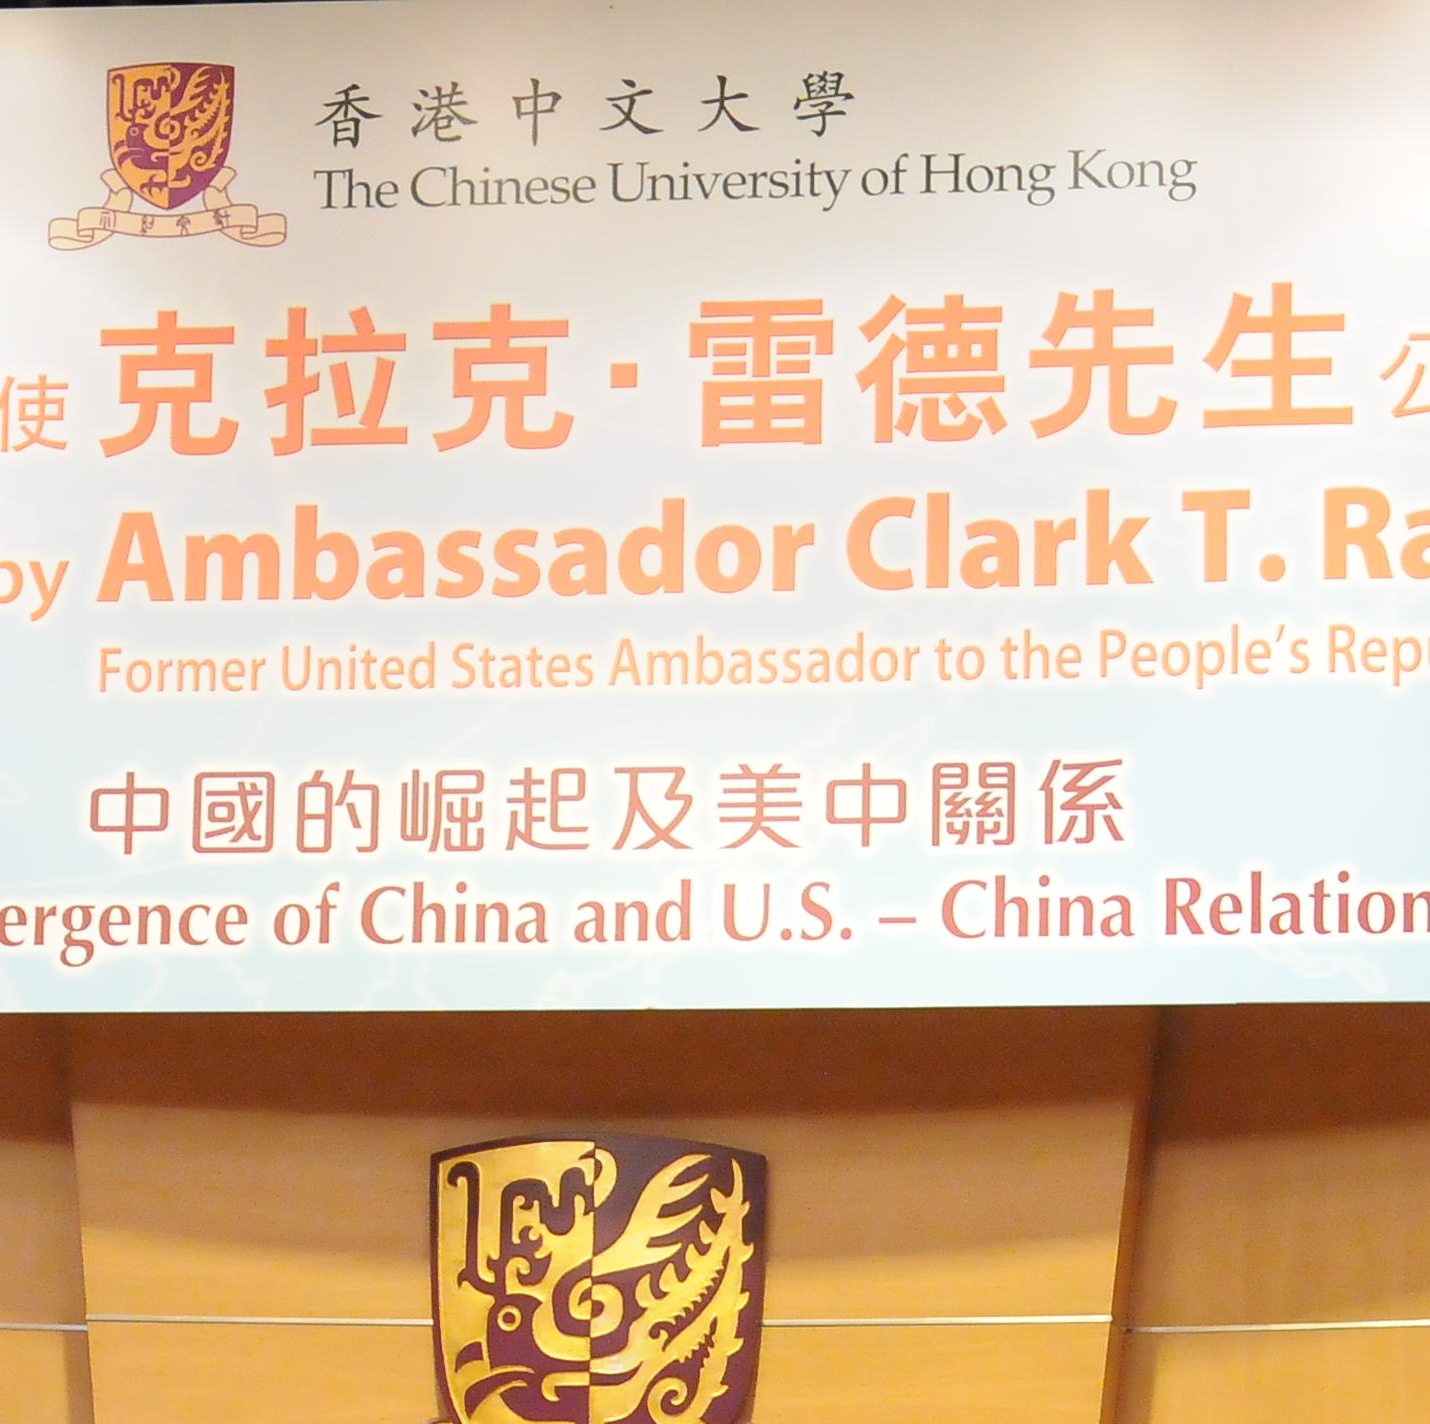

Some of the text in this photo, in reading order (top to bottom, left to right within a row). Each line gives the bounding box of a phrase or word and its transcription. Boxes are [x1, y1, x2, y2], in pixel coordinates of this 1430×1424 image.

[315, 70, 855, 148] 香港中文大學
[313, 148, 1198, 212] The Chinese University of Hong Kong
[96, 496, 815, 603] Ambassador
[846, 487, 1153, 591] Clark
[1182, 488, 1286, 583] T.
[99, 647, 267, 693] Former
[281, 640, 436, 692] United
[451, 641, 594, 689] States
[608, 631, 921, 686] Ambassador
[934, 638, 986, 681] to
[1000, 628, 1082, 680] the
[1099, 623, 1310, 690] People’s
[89, 758, 1124, 856] 中國的崛起及美中關係
[273, 881, 340, 946] of
[360, 881, 548, 945] China
[574, 878, 692, 944] and
[723, 881, 853, 942] U.S.
[941, 874, 1135, 939] China
